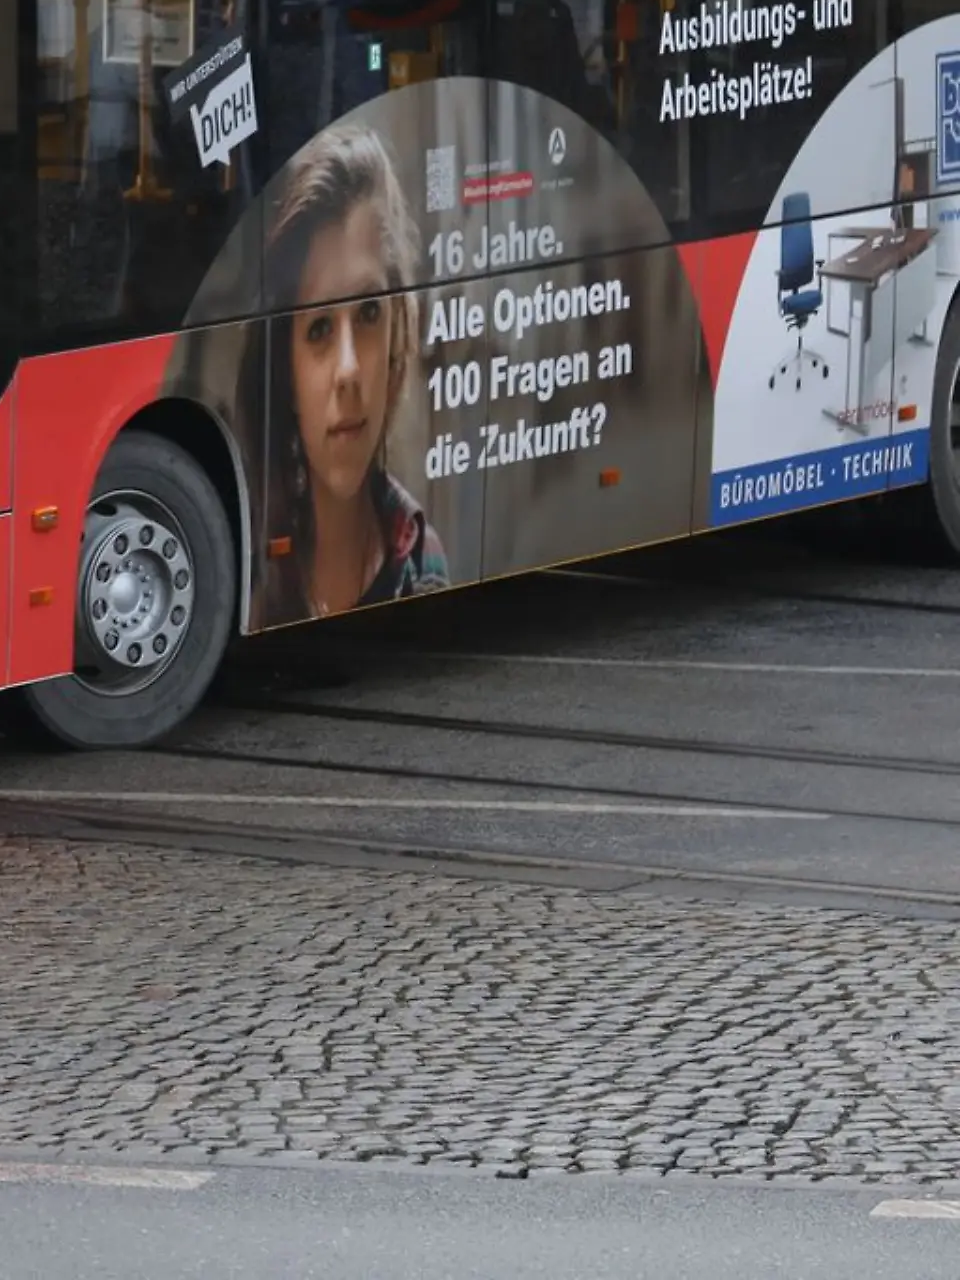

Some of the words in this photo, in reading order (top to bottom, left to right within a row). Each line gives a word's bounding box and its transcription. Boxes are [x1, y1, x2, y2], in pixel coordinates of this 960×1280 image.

[201, 82, 252, 153] DICH!
[659, 56, 813, 122] Arbeitsplätze!
[428, 229, 464, 277] 16
[473, 222, 563, 270] Jahre.
[427, 296, 484, 346] Alle
[493, 278, 631, 339] Optionen.
[428, 361, 481, 411] 100
[490, 350, 589, 402] Fragen
[598, 342, 633, 380] an
[425, 435, 470, 480] die
[477, 402, 607, 470] Zukunft?
[720, 462, 824, 508] BÜROMÖBEL
[843, 442, 913, 482] TECHNIK
